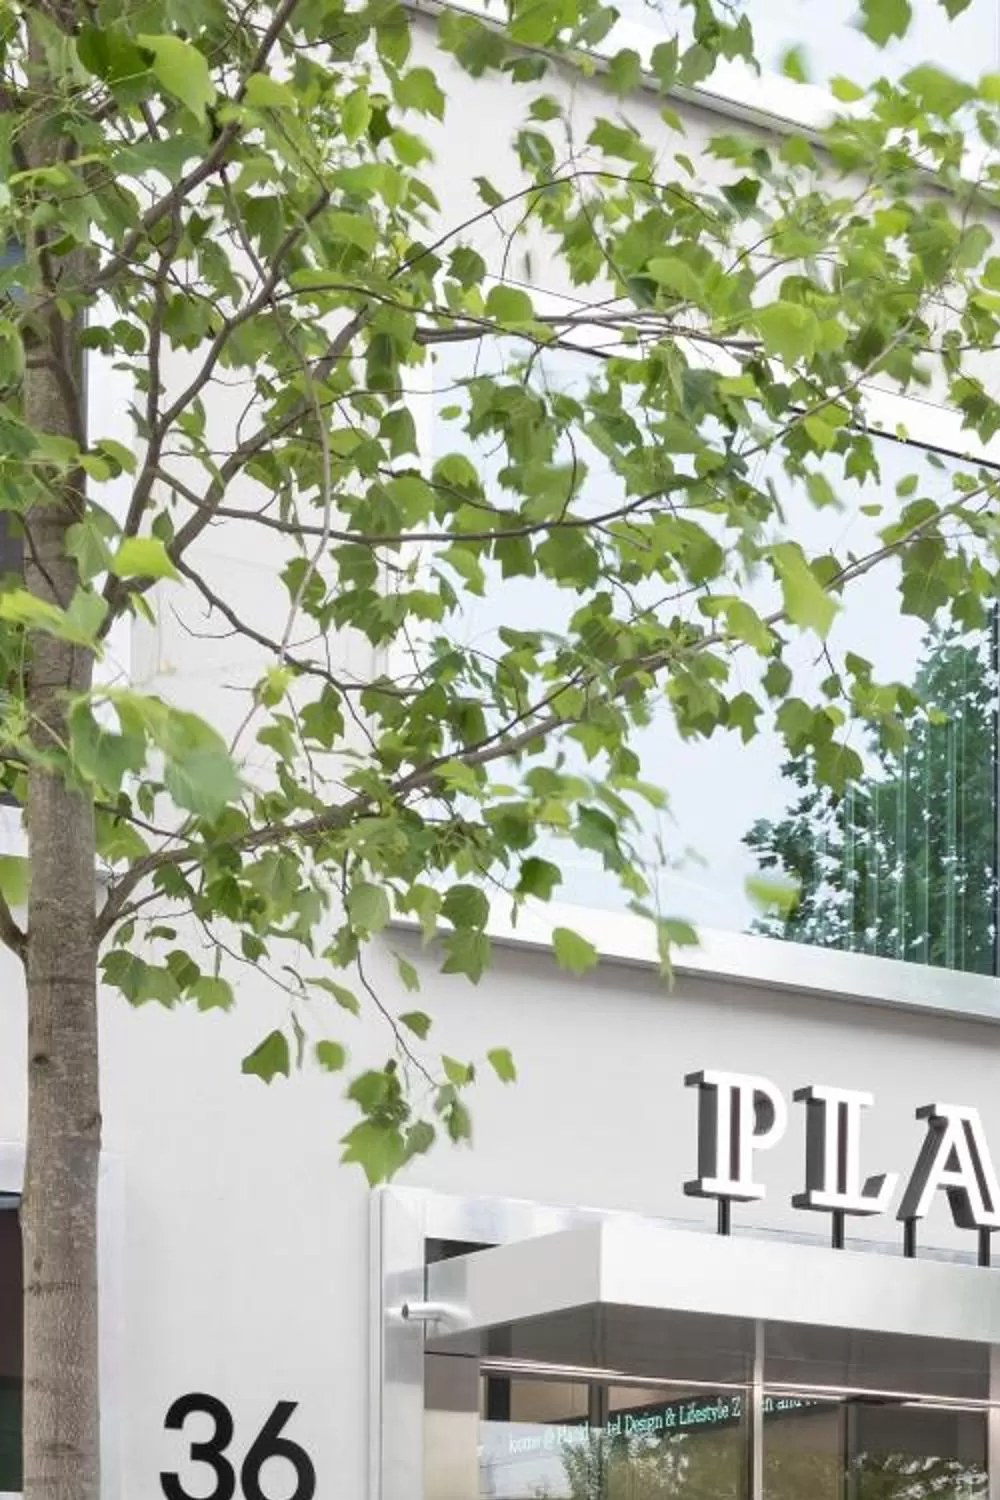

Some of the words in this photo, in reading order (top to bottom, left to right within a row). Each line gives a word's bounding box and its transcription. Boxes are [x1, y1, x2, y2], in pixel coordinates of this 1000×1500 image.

[624, 1411, 663, 1435] Design
[665, 1406, 677, 1427] &
[679, 1397, 729, 1426] Lifestyle
